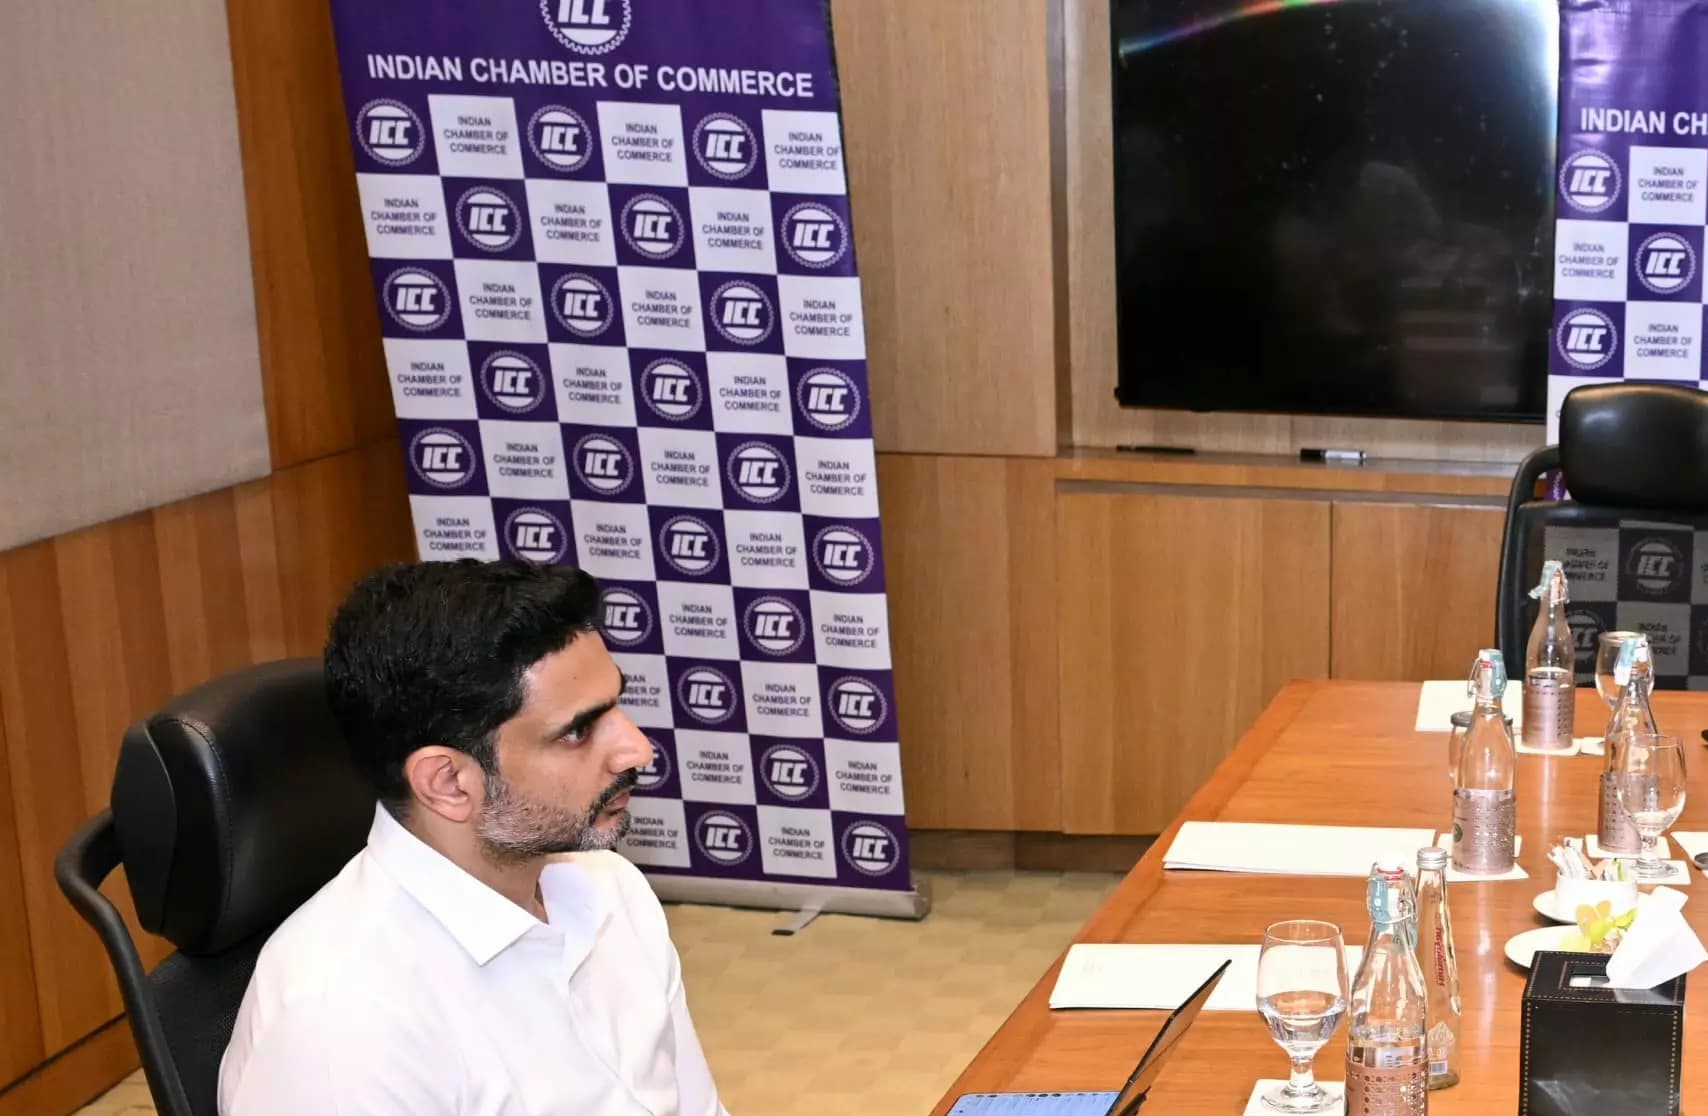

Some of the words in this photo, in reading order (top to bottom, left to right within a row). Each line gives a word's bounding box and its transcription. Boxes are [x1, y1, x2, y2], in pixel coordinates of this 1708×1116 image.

[557, 0, 611, 25] ICC
[367, 54, 463, 82] INDIAN
[470, 58, 606, 88] CHAMBER
[614, 65, 649, 91] OF
[656, 66, 814, 97] COMMERCE
[458, 116, 492, 126] INDIAN
[1580, 107, 1666, 135] INDIAN
[370, 120, 411, 145] ICC
[625, 123, 658, 134] INDIAN
[444, 129, 493, 140] CHAMBER
[495, 131, 509, 142] OF
[541, 126, 579, 151] ICC
[788, 132, 823, 142] INDIAN
[611, 136, 659, 148] CHAMBER
[661, 139, 674, 149] OF
[706, 134, 745, 159] ICC
[450, 143, 507, 155] COMMERCE
[774, 144, 824, 156] CHAMBER
[826, 147, 840, 156] OF
[617, 150, 672, 162] COMMERCE
[779, 158, 836, 170] COMMERCE
[1653, 166, 1685, 176] INDIAN
[1570, 169, 1610, 193] ICC
[1638, 179, 1684, 189] CHAMBER
[1686, 180, 1698, 190] OF
[384, 198, 419, 208] INDIAN
[1641, 192, 1693, 202] COMMERCE
[554, 204, 586, 215] INDIAN
[371, 211, 421, 222] CHAMBER
[423, 212, 437, 222] OF
[470, 207, 508, 231] ICC
[540, 216, 587, 228] CHAMBER
[589, 219, 602, 229] OF
[717, 212, 750, 222] INDIAN
[376, 224, 435, 235] COMMERCE
[634, 214, 671, 239] ICC
[702, 225, 751, 236] CHAMBER
[753, 227, 765, 237] OF
[546, 230, 600, 242] COMMERCE
[794, 223, 834, 247] ICC
[708, 238, 763, 250] COMMERCE
[1646, 252, 1685, 274] ICC
[397, 288, 437, 311] ICC
[564, 293, 600, 317] ICC
[803, 300, 836, 310] INDIAN
[723, 301, 762, 325] ICC
[789, 312, 837, 323] CHAMBER
[840, 314, 852, 323] OF
[795, 325, 849, 336] COMMERCE
[1648, 324, 1679, 333] INDIAN
[1567, 327, 1606, 350] ICC
[1634, 336, 1678, 345] CHAMBER
[1680, 337, 1692, 345] OF
[1637, 348, 1688, 358] COMMERCE
[494, 370, 532, 393] ICC
[734, 376, 767, 385] INDIAN
[653, 378, 690, 401] ICC
[719, 388, 768, 398] CHAMBER
[769, 390, 782, 399] OF
[809, 387, 848, 411] ICC
[724, 401, 780, 412] COMMERCE
[423, 447, 462, 469] ICC
[585, 453, 621, 476] ICC
[818, 460, 850, 470] INDIAN
[740, 461, 778, 484] ICC
[805, 472, 851, 483] CHAMBER
[853, 474, 866, 483] OF
[810, 484, 863, 495] COMMERCE
[517, 526, 554, 548] ICC
[749, 533, 782, 542] INDIAN
[672, 534, 708, 557] ICC
[736, 544, 783, 554] CHAMBER
[785, 546, 797, 555] OF
[824, 544, 861, 567] ICC
[741, 557, 795, 568] COMMERCE
[833, 614, 864, 624] INDIAN
[756, 615, 793, 636] ICC
[821, 624, 864, 636] CHAMBER
[867, 628, 879, 636] OF
[825, 636, 876, 648] COMMERCE
[765, 683, 796, 693] INDIAN
[689, 684, 725, 706] ICC
[752, 693, 797, 705] CHAMBER
[799, 696, 812, 705] OF
[839, 694, 875, 716] ICC
[757, 706, 809, 717] COMMERCE
[772, 762, 807, 783] ICC
[706, 827, 741, 848] ICC
[853, 838, 888, 859] ICC
